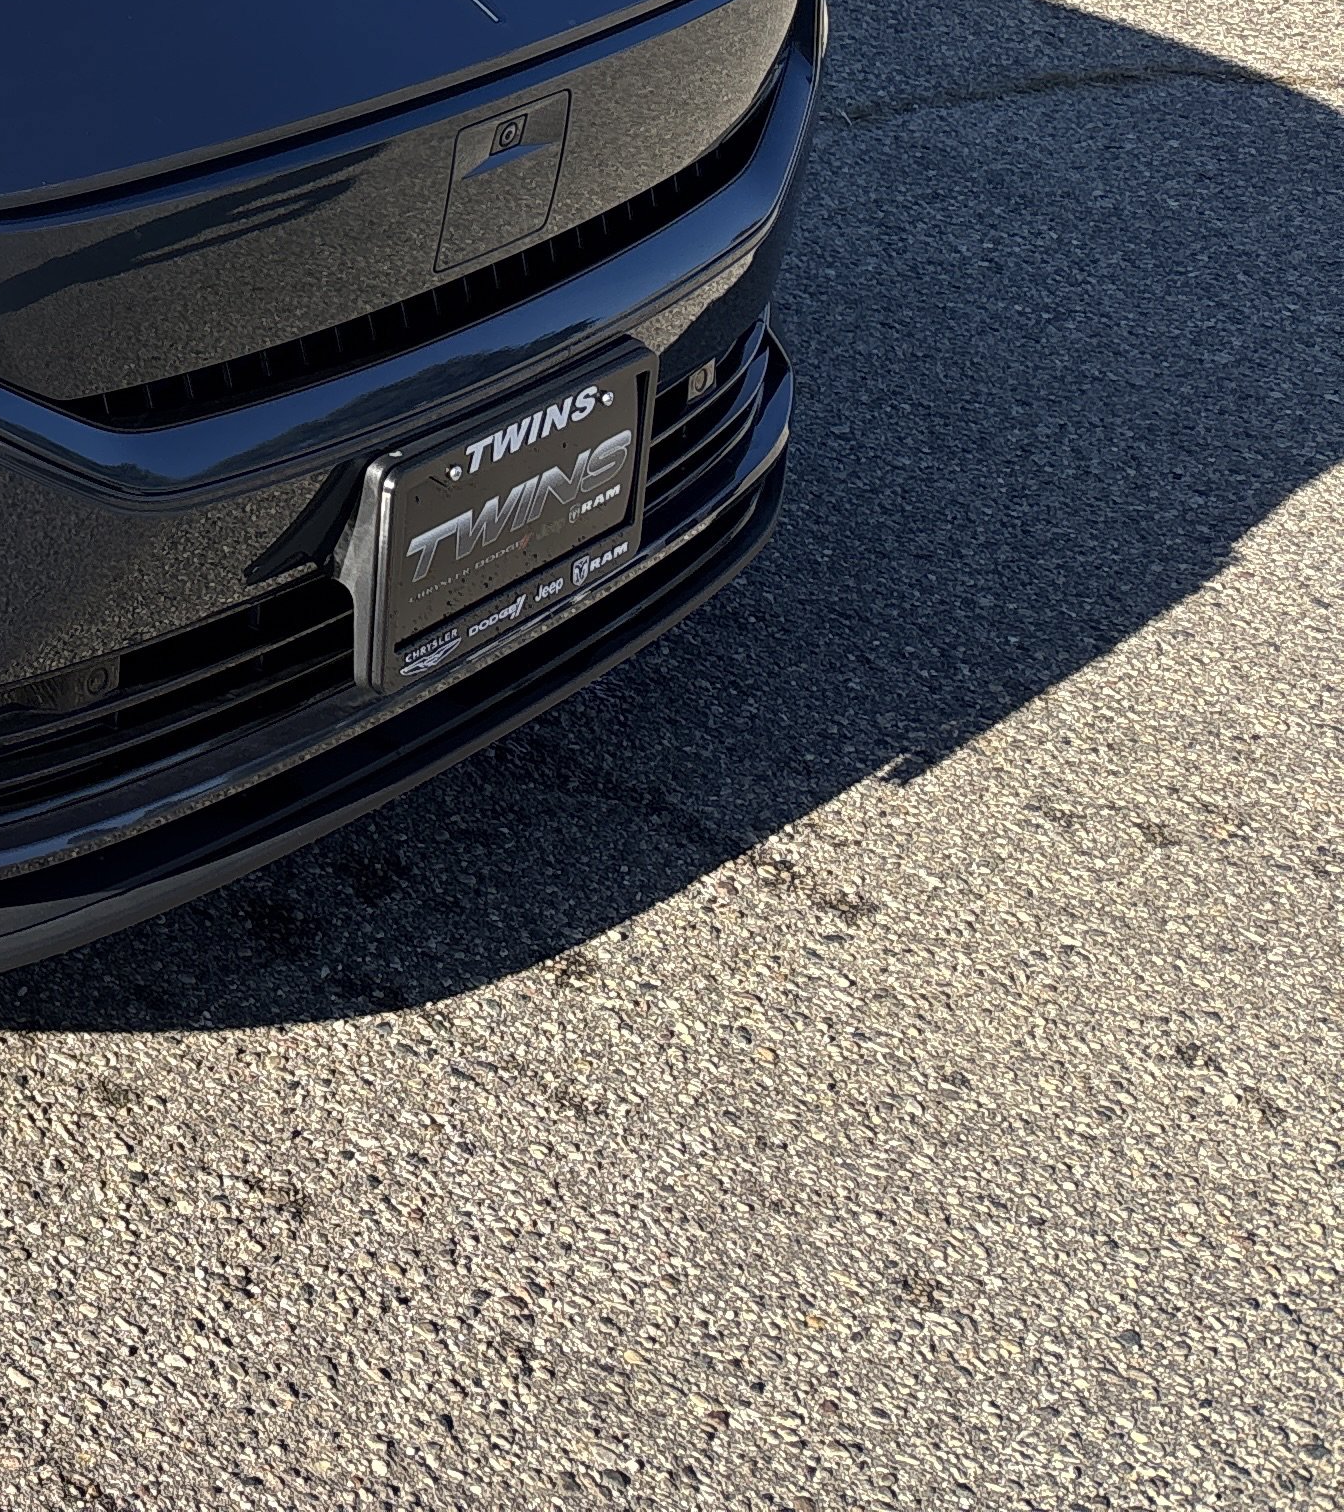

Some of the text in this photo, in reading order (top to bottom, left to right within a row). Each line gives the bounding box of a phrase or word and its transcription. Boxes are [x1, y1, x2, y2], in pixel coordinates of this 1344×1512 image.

[466, 386, 598, 473] TWINS
[407, 430, 632, 583] TWINS
[581, 485, 621, 514] RAM
[405, 541, 629, 664] CHRYSLER DODGE Jeep RAM
